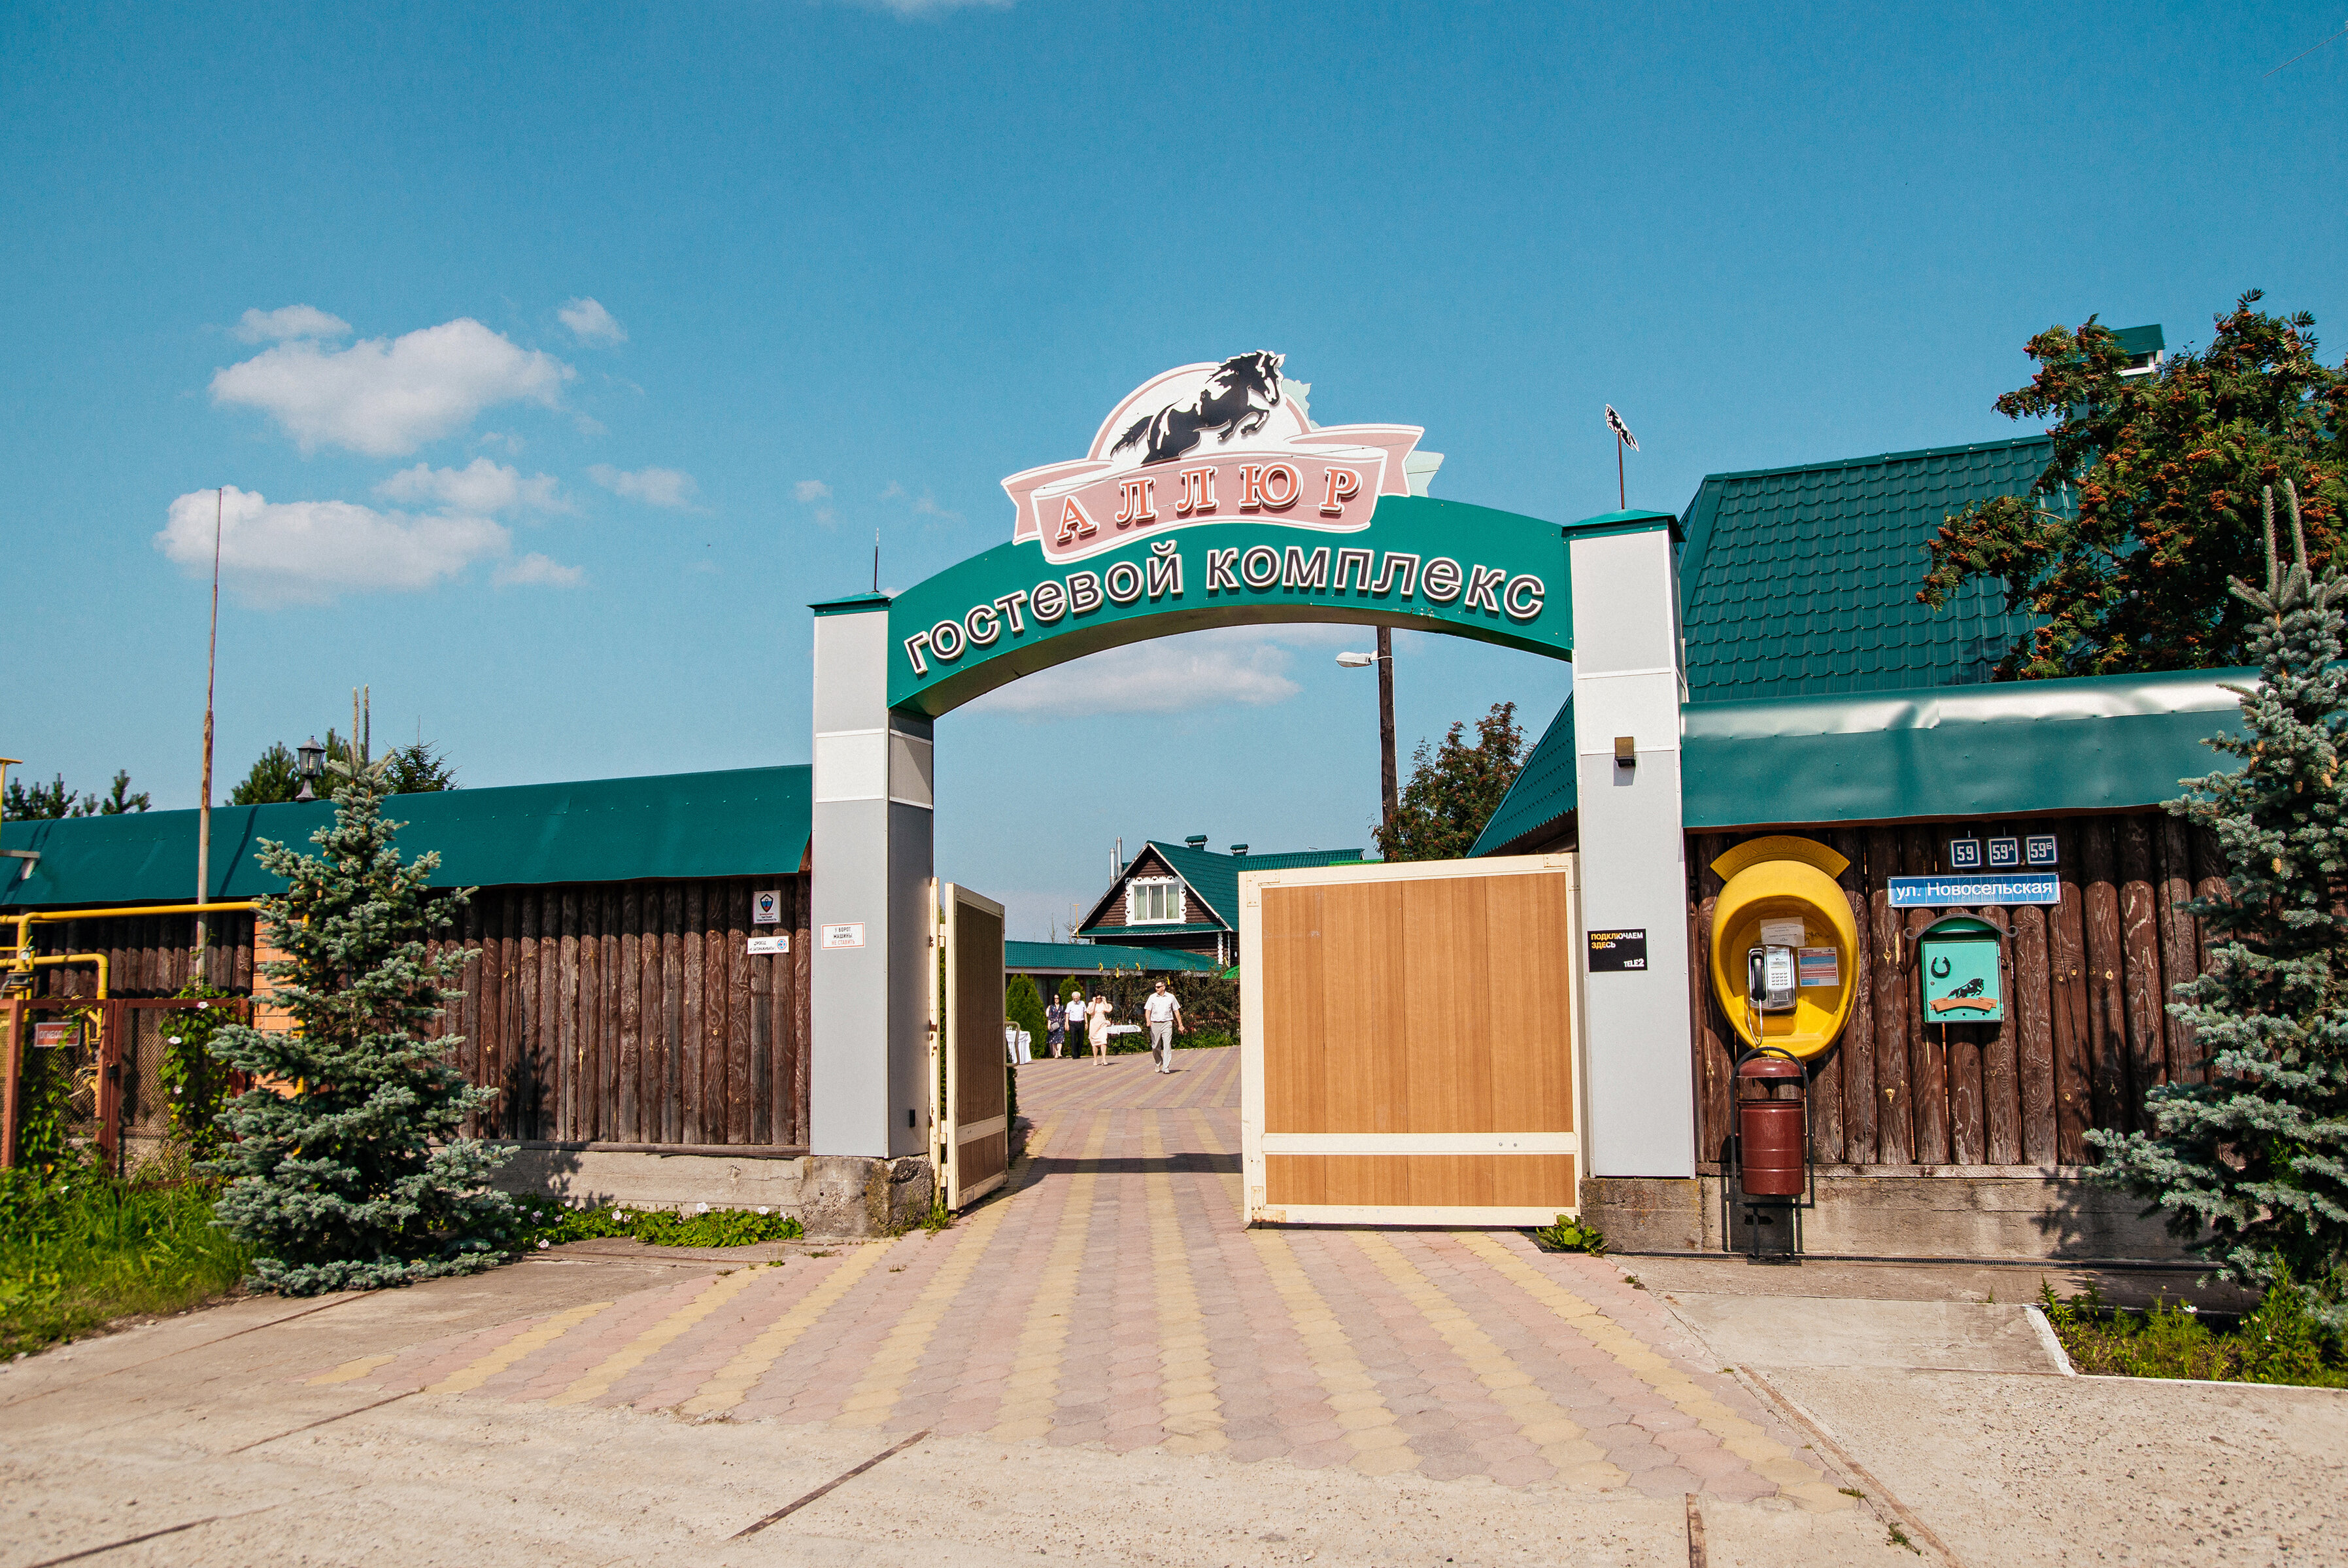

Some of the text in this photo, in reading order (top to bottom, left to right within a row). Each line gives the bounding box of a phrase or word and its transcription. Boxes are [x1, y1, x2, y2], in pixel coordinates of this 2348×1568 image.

[1055, 462, 1363, 542] АЛЛЮР
[1957, 845, 1975, 862] 59
[1896, 882, 2054, 900] ул. Новосельская
[1590, 932, 1643, 941] ПОДКЛЮЧАЕМ
[1624, 958, 1644, 967] TELE2
